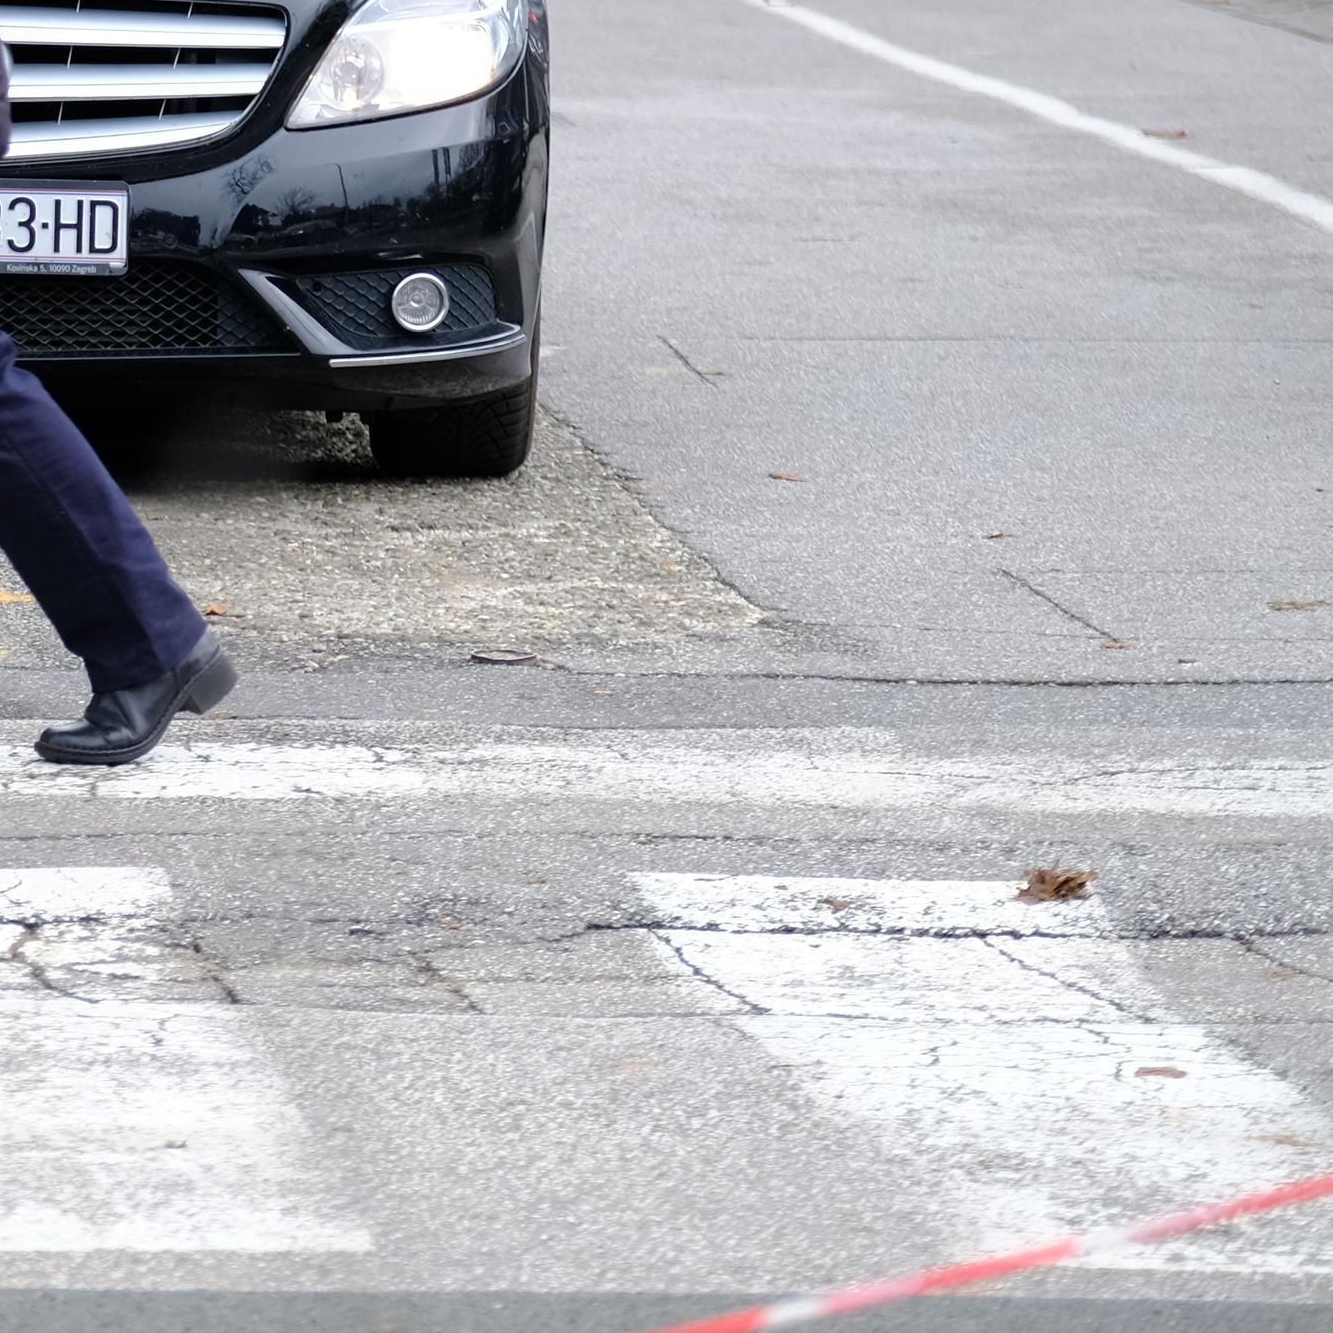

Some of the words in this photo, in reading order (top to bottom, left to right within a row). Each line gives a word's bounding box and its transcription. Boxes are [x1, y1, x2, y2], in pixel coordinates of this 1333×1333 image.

[6, 264, 38, 273] Kovinska
[39, 264, 47, 273] 5,
[49, 264, 71, 273] 10090
[72, 265, 97, 275] Zagreb
